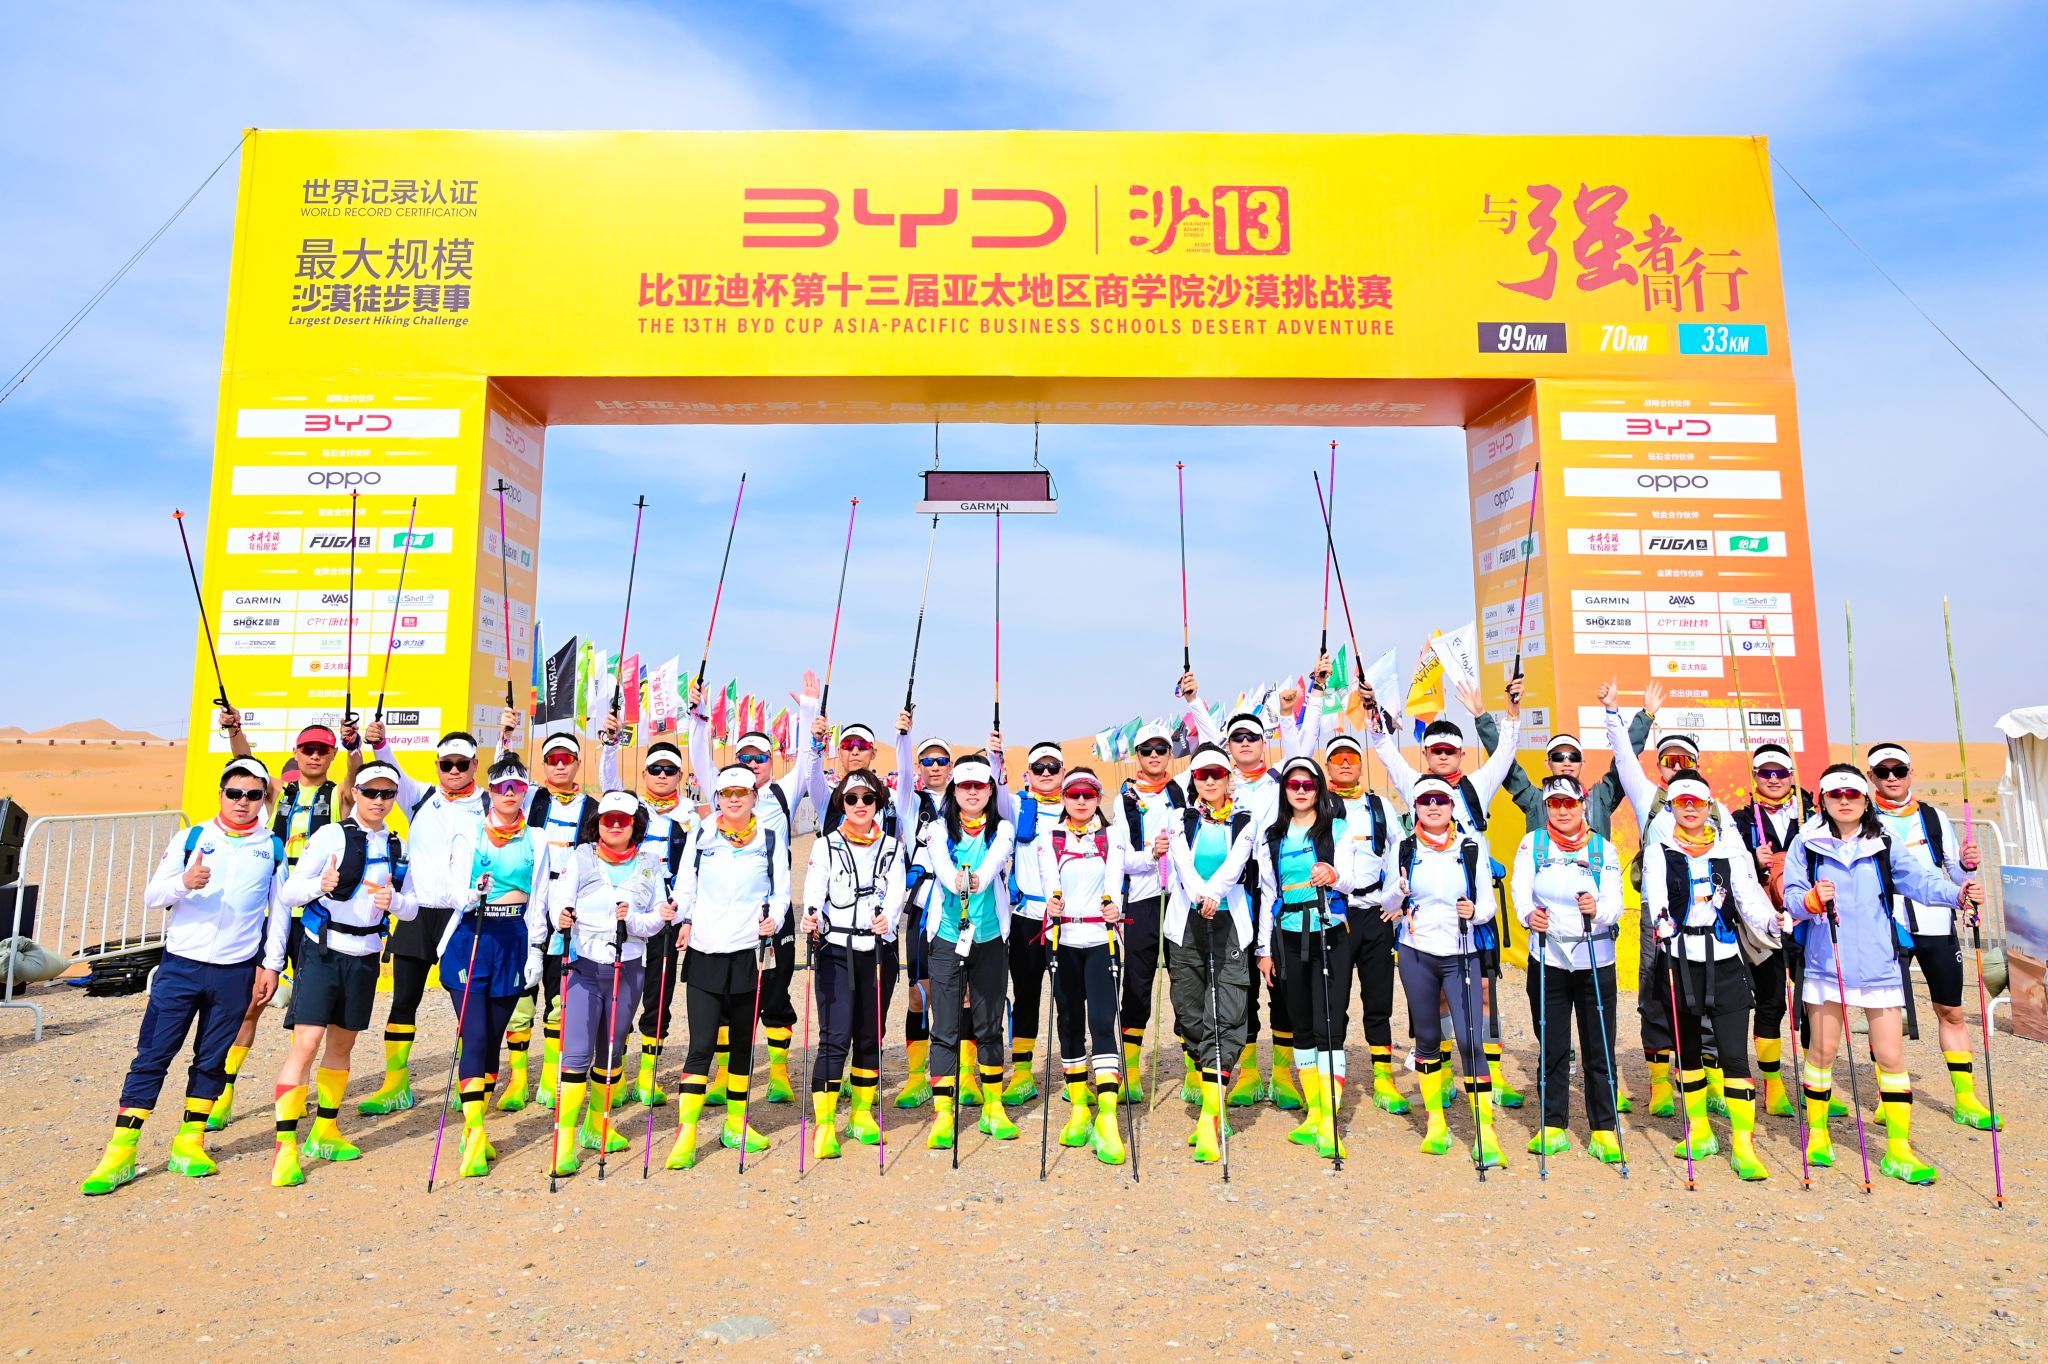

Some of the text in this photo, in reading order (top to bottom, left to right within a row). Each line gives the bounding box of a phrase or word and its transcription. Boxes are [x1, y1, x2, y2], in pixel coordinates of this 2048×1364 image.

[302, 178, 479, 206] 世界记录认证
[300, 207, 477, 218] WORLD RECORD CERTIFICATION
[743, 188, 1068, 249] BYD
[294, 237, 475, 281] 最大规模
[291, 283, 472, 313] 沙漠徒步赛事
[638, 272, 1394, 310] 比亚迪杯第十三届亚太地区商学院沙漠挑战赛
[288, 315, 469, 327] Largest Desert Hiking Challenge
[639, 318, 1394, 335] THE 13TH BYD CUP ASIA-PACIFIC BUSINESS SCHOOLS DESERT ADVENTURE
[1497, 324, 1547, 352] 99KM
[1600, 325, 1648, 352] 70KM
[1701, 326, 1749, 354] 33KM
[304, 414, 392, 432] BYD
[1626, 418, 1712, 436] BYD
[1488, 433, 1514, 460] BYD
[960, 502, 1009, 511] GARMIN
[235, 596, 281, 605] GARMIN
[1585, 596, 1630, 605] GARMIN
[233, 618, 264, 627] SHOKZ
[1586, 617, 1616, 627] SHOKZ
[2002, 874, 2027, 886] BYD
